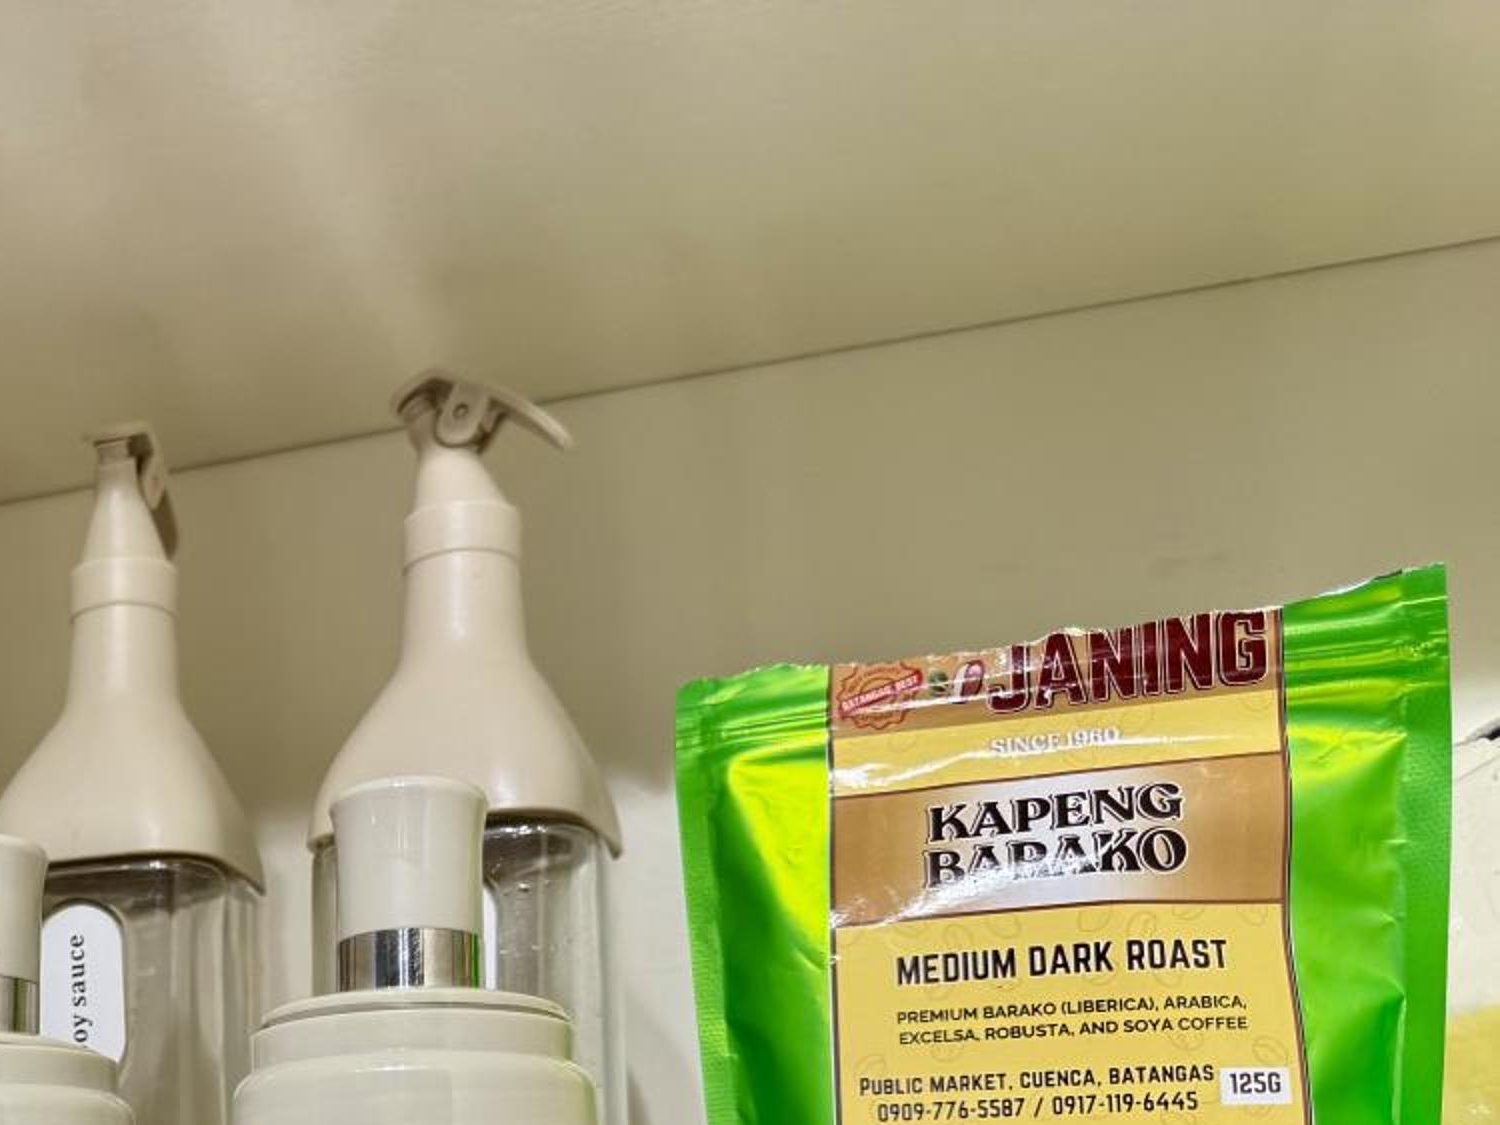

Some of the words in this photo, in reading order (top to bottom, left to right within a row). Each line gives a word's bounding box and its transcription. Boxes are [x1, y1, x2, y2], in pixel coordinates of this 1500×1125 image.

[987, 611, 1268, 712] JANING
[990, 733, 1061, 755] SINCE
[1066, 727, 1121, 750] 1960
[925, 783, 1182, 843] KAPENG
[923, 827, 1188, 889] BARAKO
[70, 934, 87, 1007] sauce
[897, 947, 1017, 986] MEDIUM
[1028, 941, 1114, 976] DARK
[1126, 939, 1227, 970] ROAST
[897, 1007, 978, 1025] PREMIUM
[983, 1002, 1057, 1019] BARAKO
[1061, 997, 1159, 1015] (LIBERICA),
[1164, 995, 1247, 1010] ARABICA,
[985, 1022, 1075, 1040] ROBUSTA,
[1079, 1020, 1119, 1035] AND
[1123, 1018, 1173, 1033] SOYA
[1177, 1016, 1248, 1031] COFFEE
[859, 1077, 923, 1096] PUBLIC
[1019, 1069, 1102, 1089] CUENCA,
[1108, 1064, 1215, 1085] BATANGAS
[1228, 1071, 1282, 1095] 125G
[877, 1097, 1025, 1123] 0909-776-5587
[1033, 1097, 1044, 1119] /
[1052, 1091, 1199, 1116] 0917-119-6445
